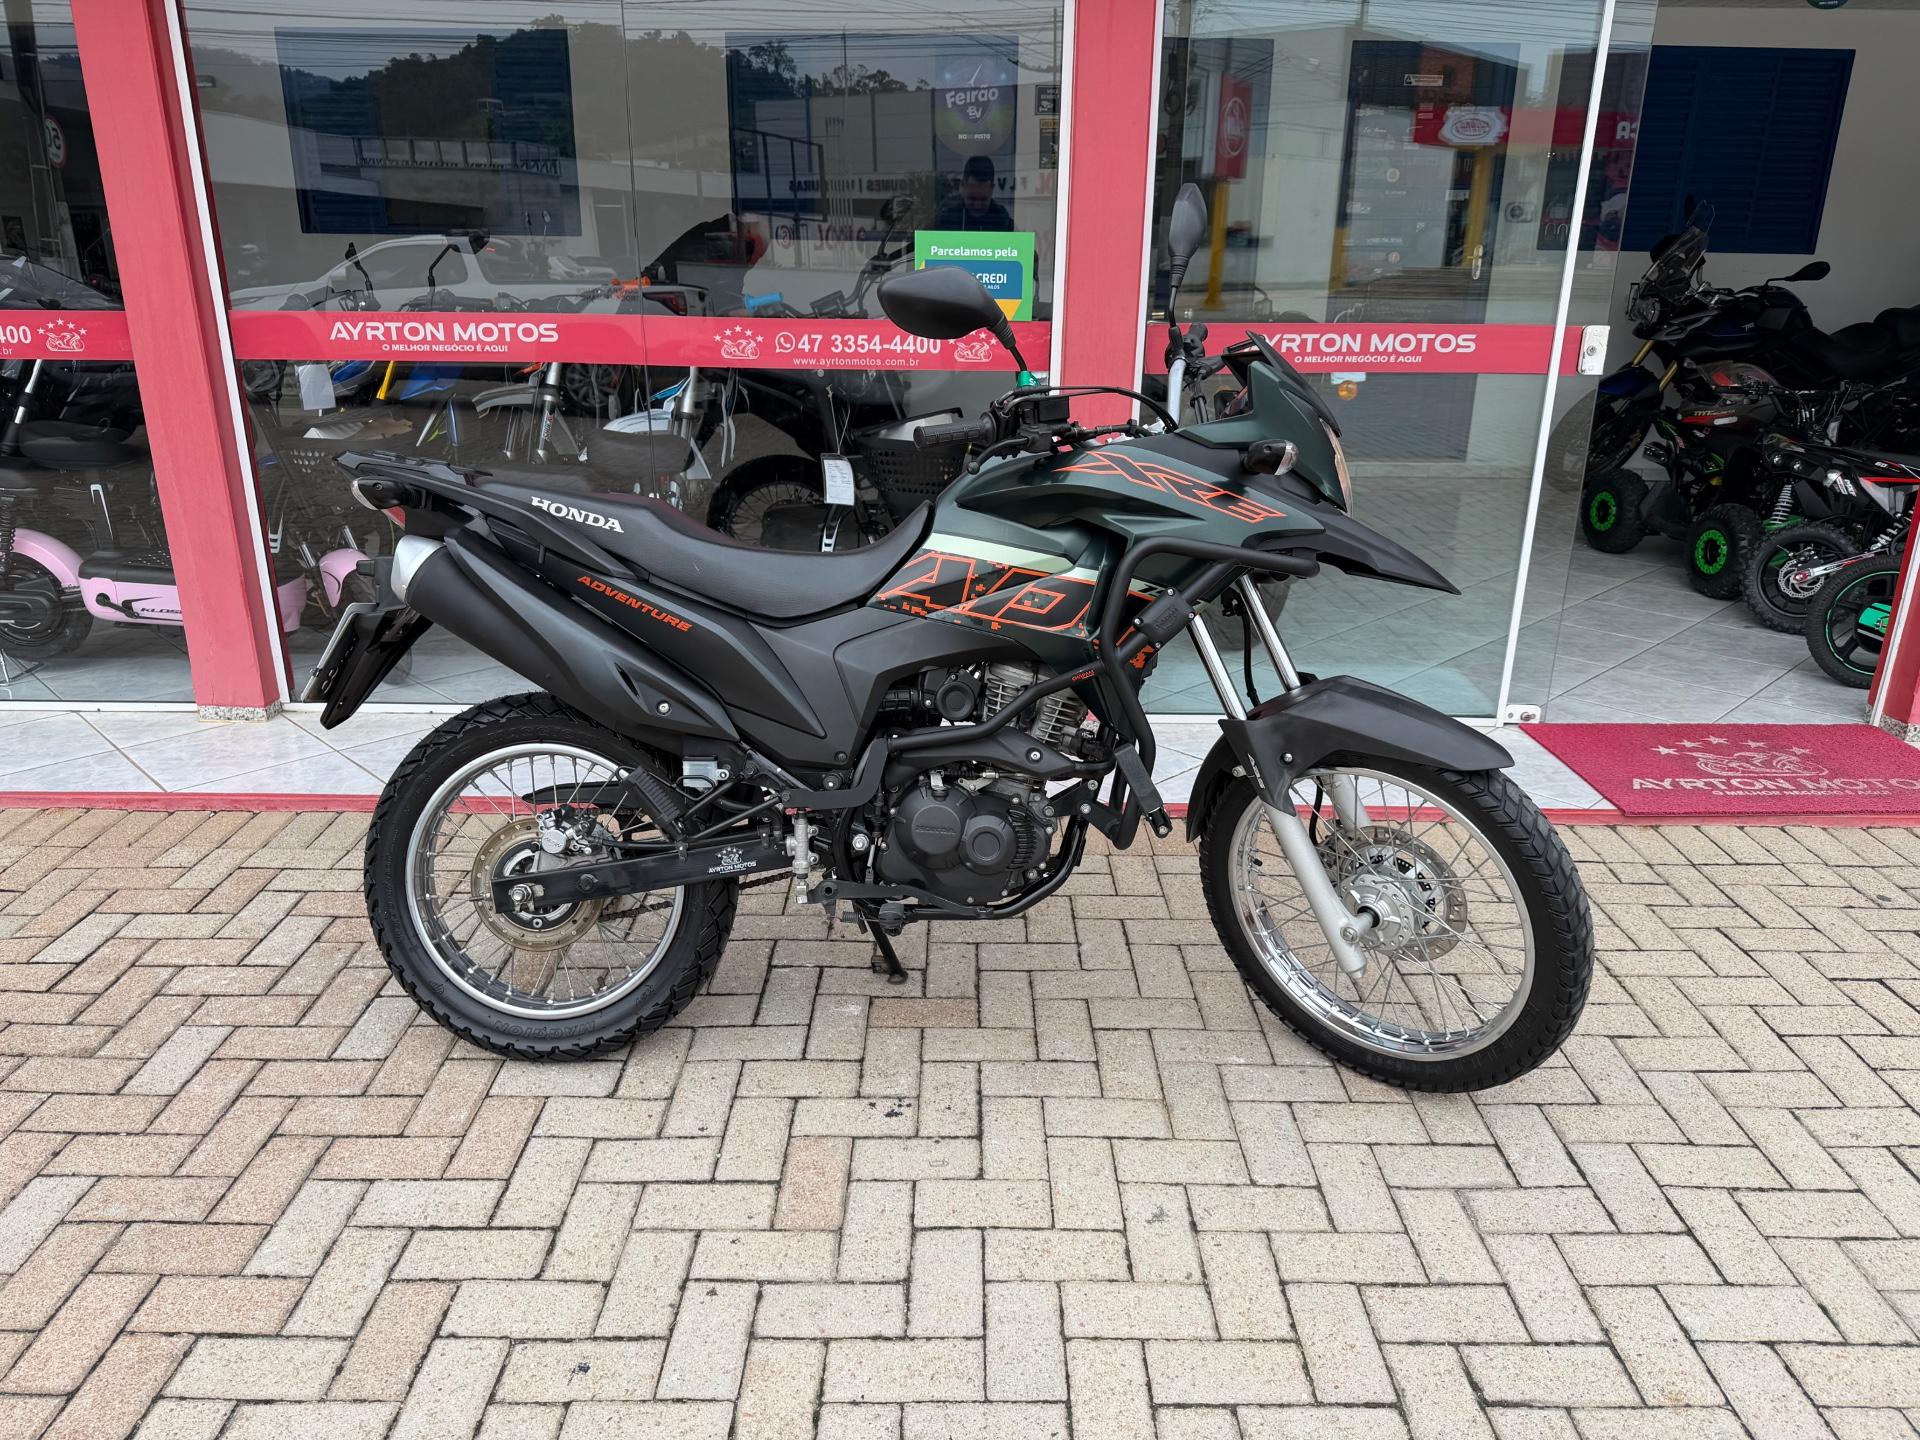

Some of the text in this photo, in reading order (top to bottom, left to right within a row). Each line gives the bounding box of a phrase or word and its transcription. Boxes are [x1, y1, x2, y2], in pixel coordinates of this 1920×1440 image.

[945, 85, 999, 108] Feirão
[930, 245, 1018, 258] Parcelamos pela
[972, 273, 1007, 284] CREDI
[330, 321, 559, 343] AYRTON MOTOS
[391, 344, 430, 352] MELHOR
[431, 343, 475, 352] NEGÓCIO
[476, 343, 482, 352] É
[484, 344, 508, 353] AQUI
[797, 334, 941, 354] 47 3354-4400
[1250, 333, 1477, 353] YRTON MOTOS
[793, 358, 919, 367] www.ayrtonmotos.com.br
[1304, 355, 1343, 363] MELHOR
[1345, 354, 1388, 363] NEGÓCIO
[1389, 354, 1396, 363] É
[1397, 355, 1422, 363] AQUI
[531, 496, 625, 534] HONDA
[577, 575, 694, 632] ADVENTURE
[1632, 778, 1790, 790] AYRTON
[708, 864, 733, 874] AYRTON
[734, 861, 757, 870] MOTOS
